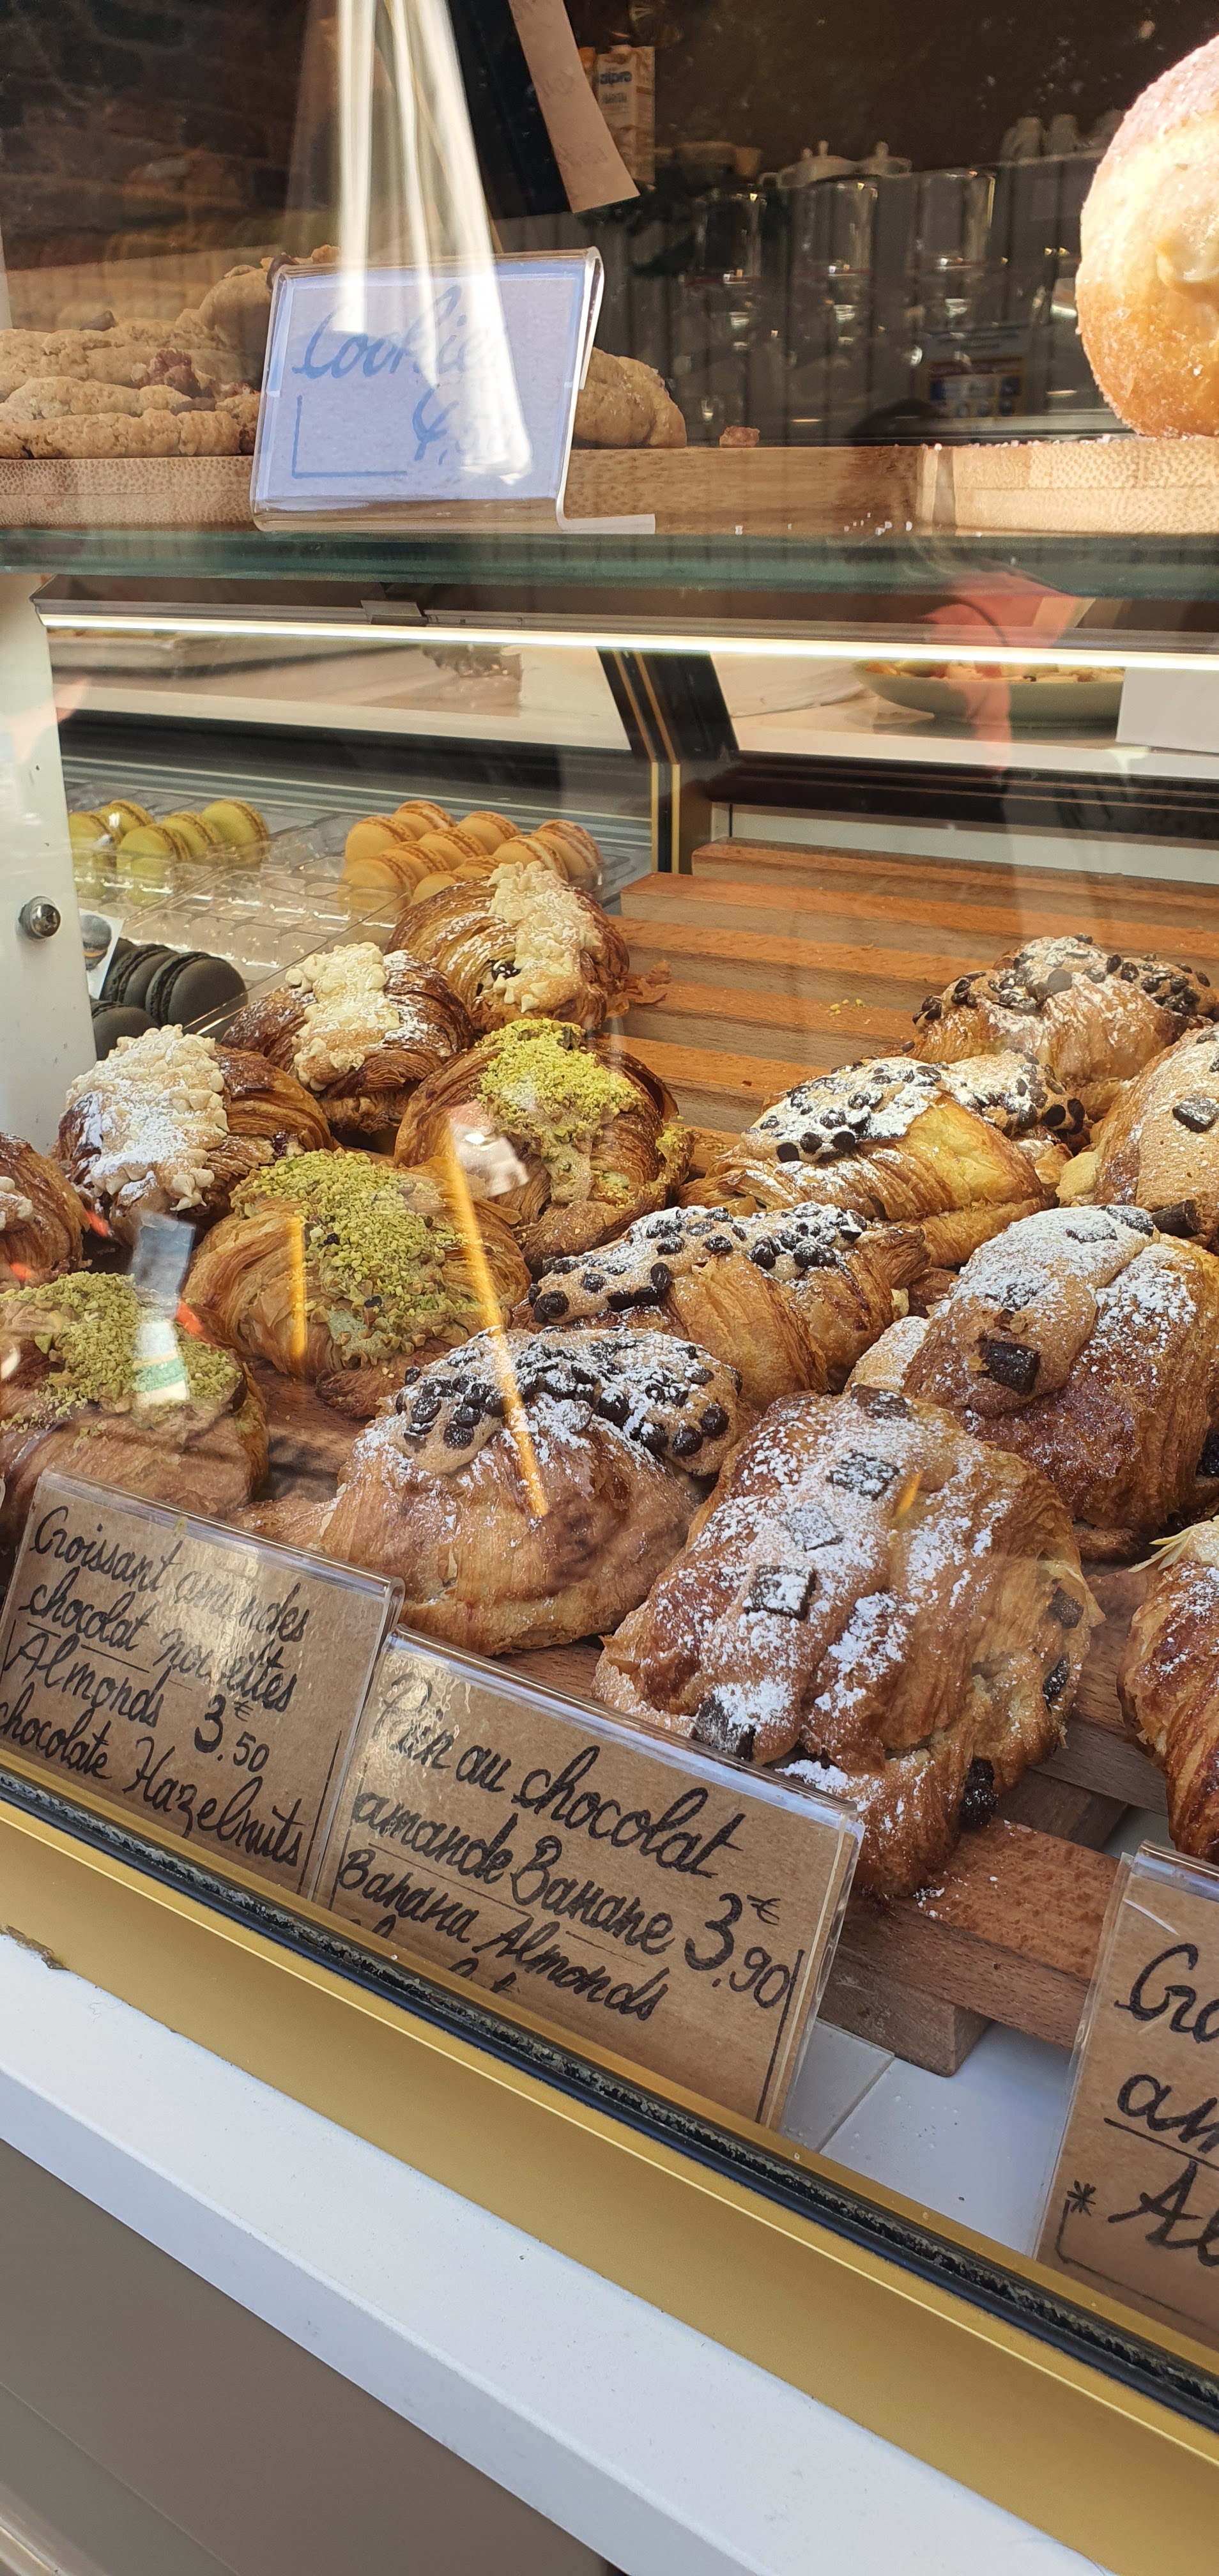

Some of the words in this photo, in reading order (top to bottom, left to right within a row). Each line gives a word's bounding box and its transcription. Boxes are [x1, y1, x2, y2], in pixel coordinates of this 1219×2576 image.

[291, 285, 502, 379] Cookie
[19, 1567, 159, 1651] chocolat
[153, 1628, 298, 1713] noiettes
[30, 1506, 183, 1592] Croissant
[174, 1570, 310, 1643] amndes
[3, 1632, 164, 1728] Almonds
[121, 1736, 302, 1866] Hazelnuts
[353, 1792, 516, 1882] amande
[371, 1671, 451, 1769] Pin
[456, 1745, 511, 1792] au
[512, 1745, 744, 1878] chocolat
[340, 1850, 479, 1943] Banana
[472, 1917, 670, 2021] Almonds
